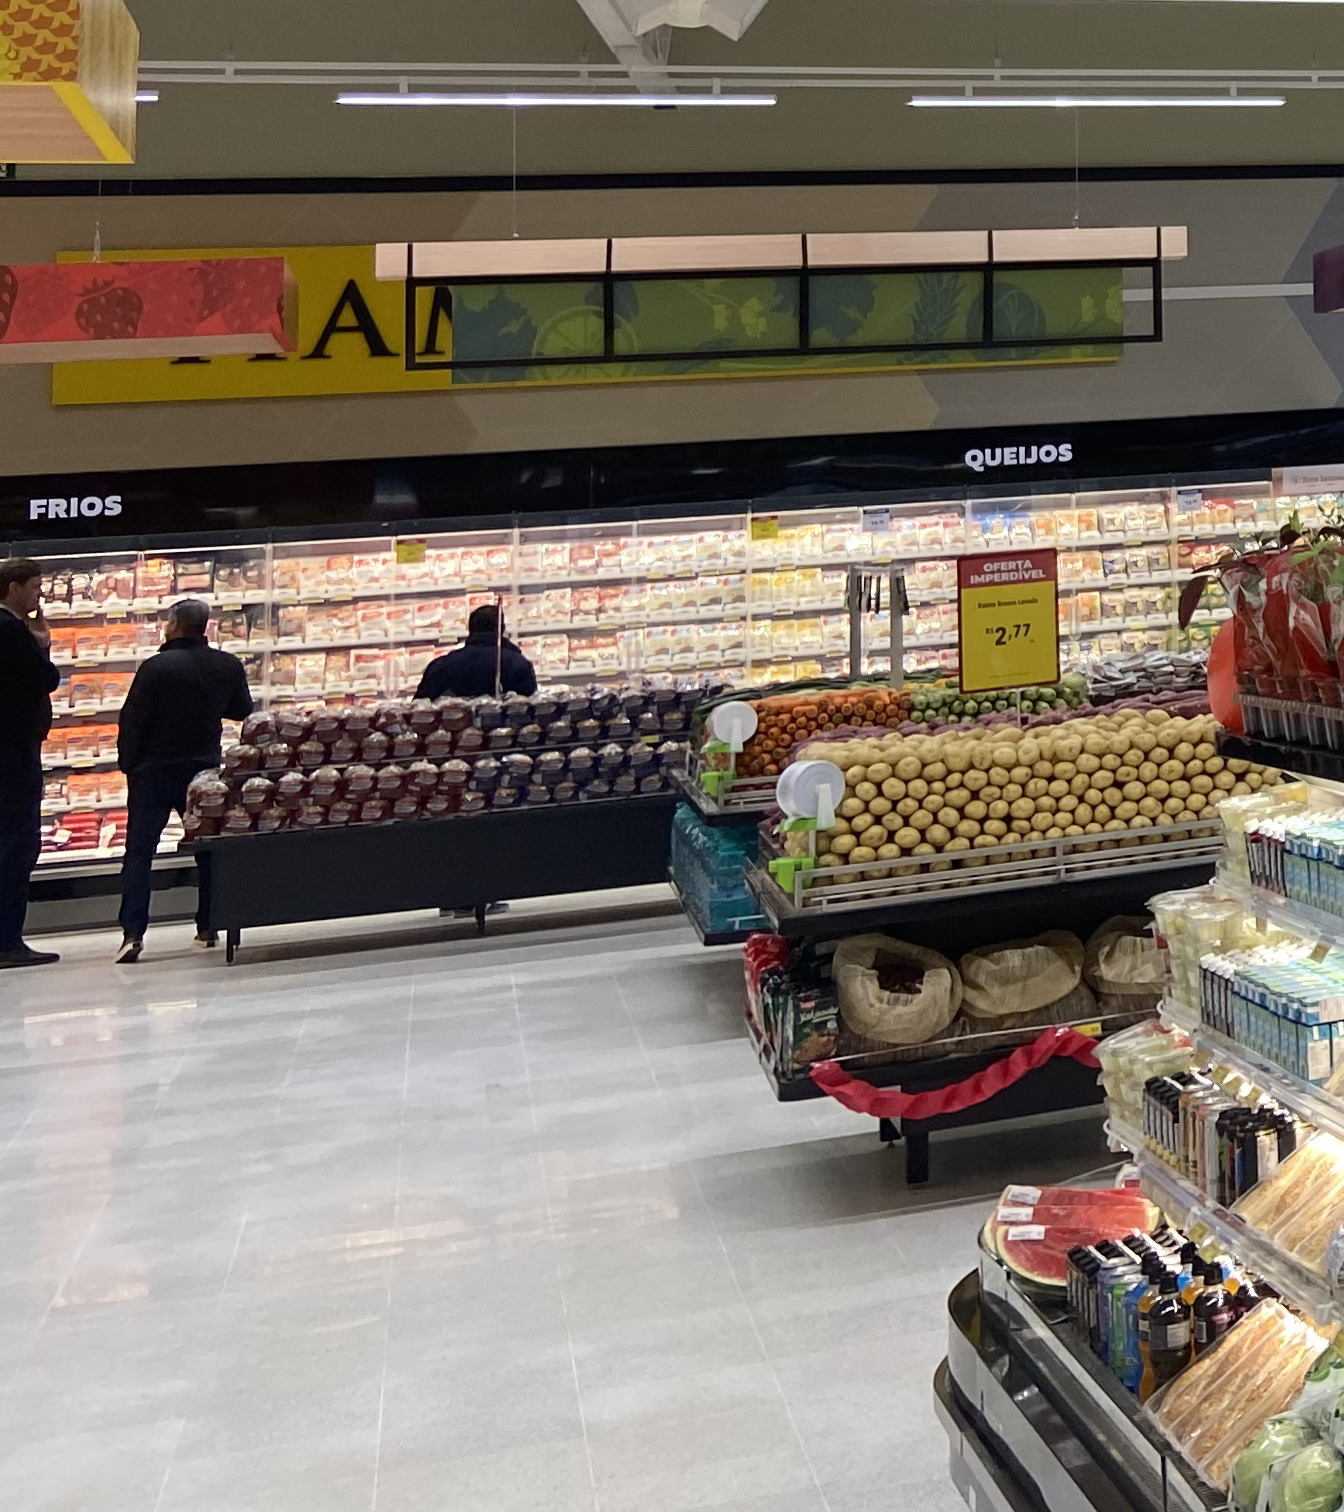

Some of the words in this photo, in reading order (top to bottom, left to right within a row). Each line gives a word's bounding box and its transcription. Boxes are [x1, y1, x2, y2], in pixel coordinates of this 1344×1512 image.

[964, 443, 1073, 472] QUEIJOS
[29, 495, 123, 519] FRIOS
[970, 568, 1046, 584] IMPERDÍVEL
[983, 560, 1033, 573] OFERTA
[995, 624, 1031, 646] 2,77
